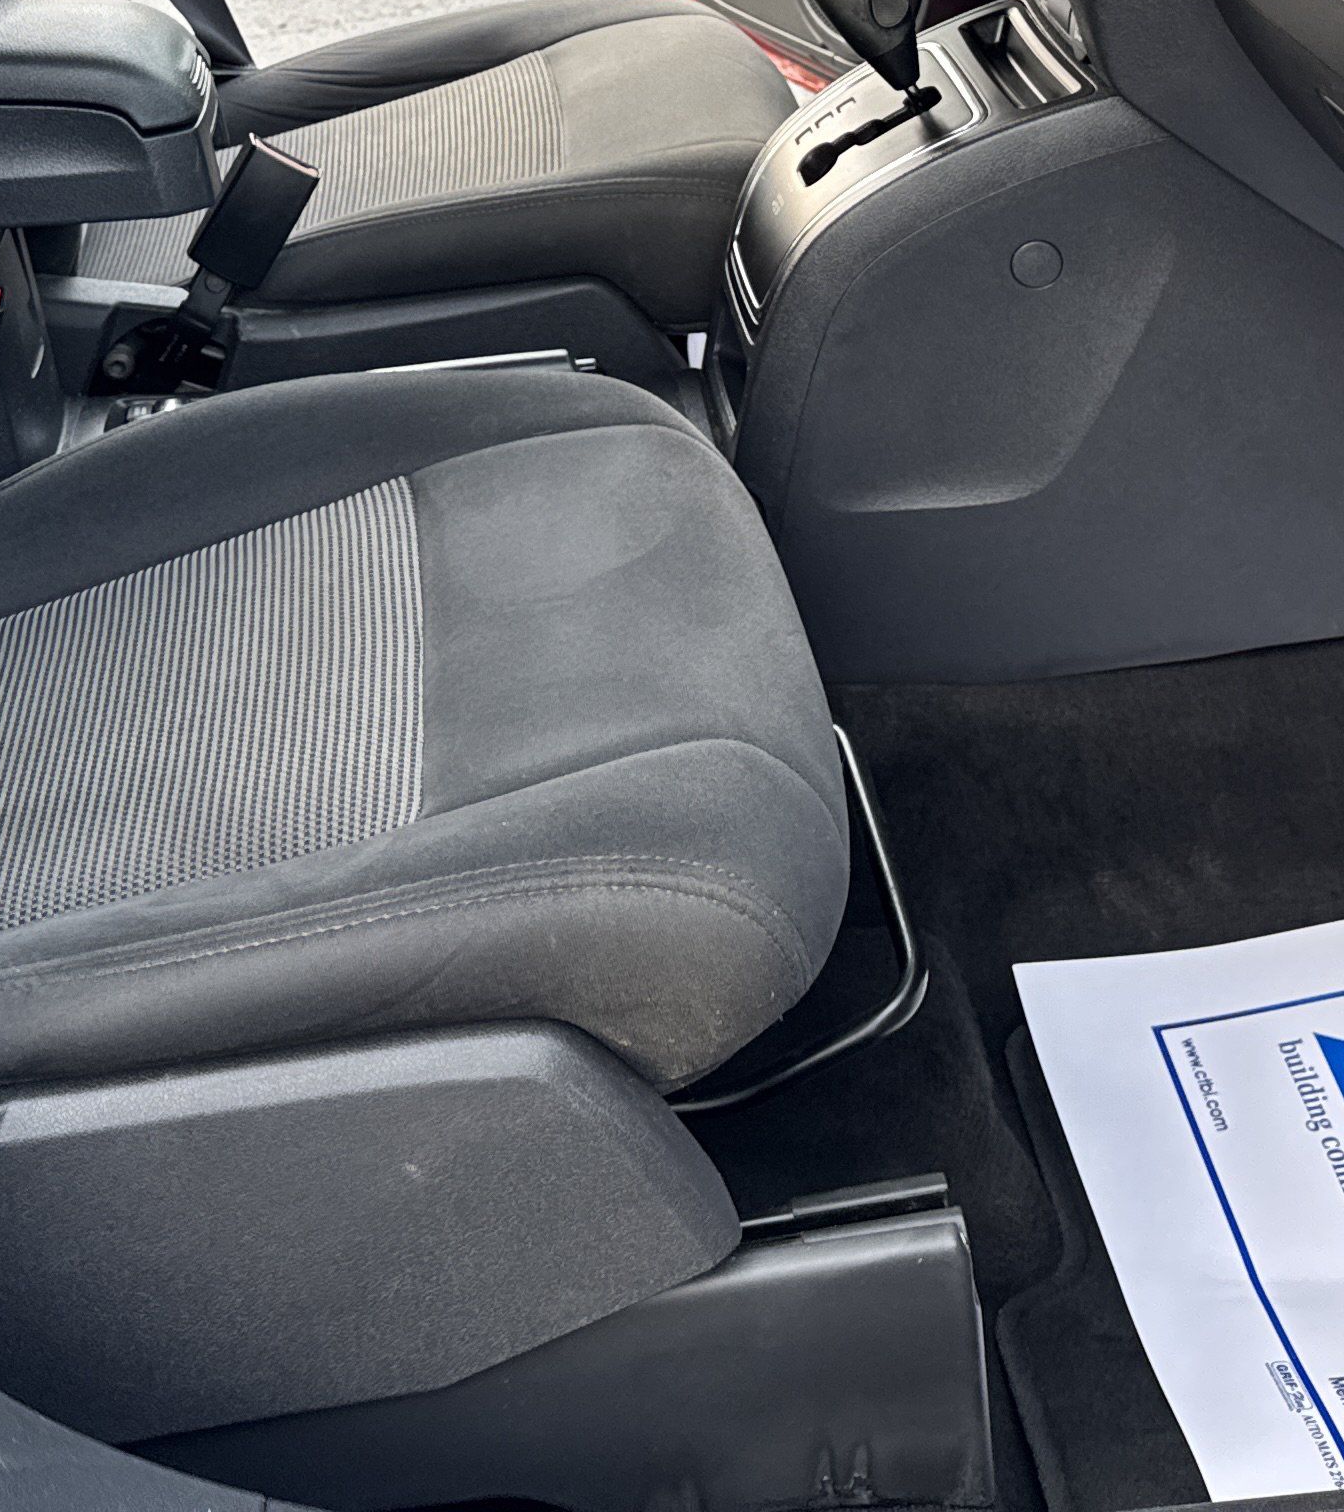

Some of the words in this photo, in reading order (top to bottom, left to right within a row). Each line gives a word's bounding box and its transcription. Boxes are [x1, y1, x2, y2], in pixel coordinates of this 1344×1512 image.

[1277, 1038, 1332, 1133] building
[1301, 1414, 1324, 1440] AUTO
[1314, 1441, 1339, 1469] MATS
